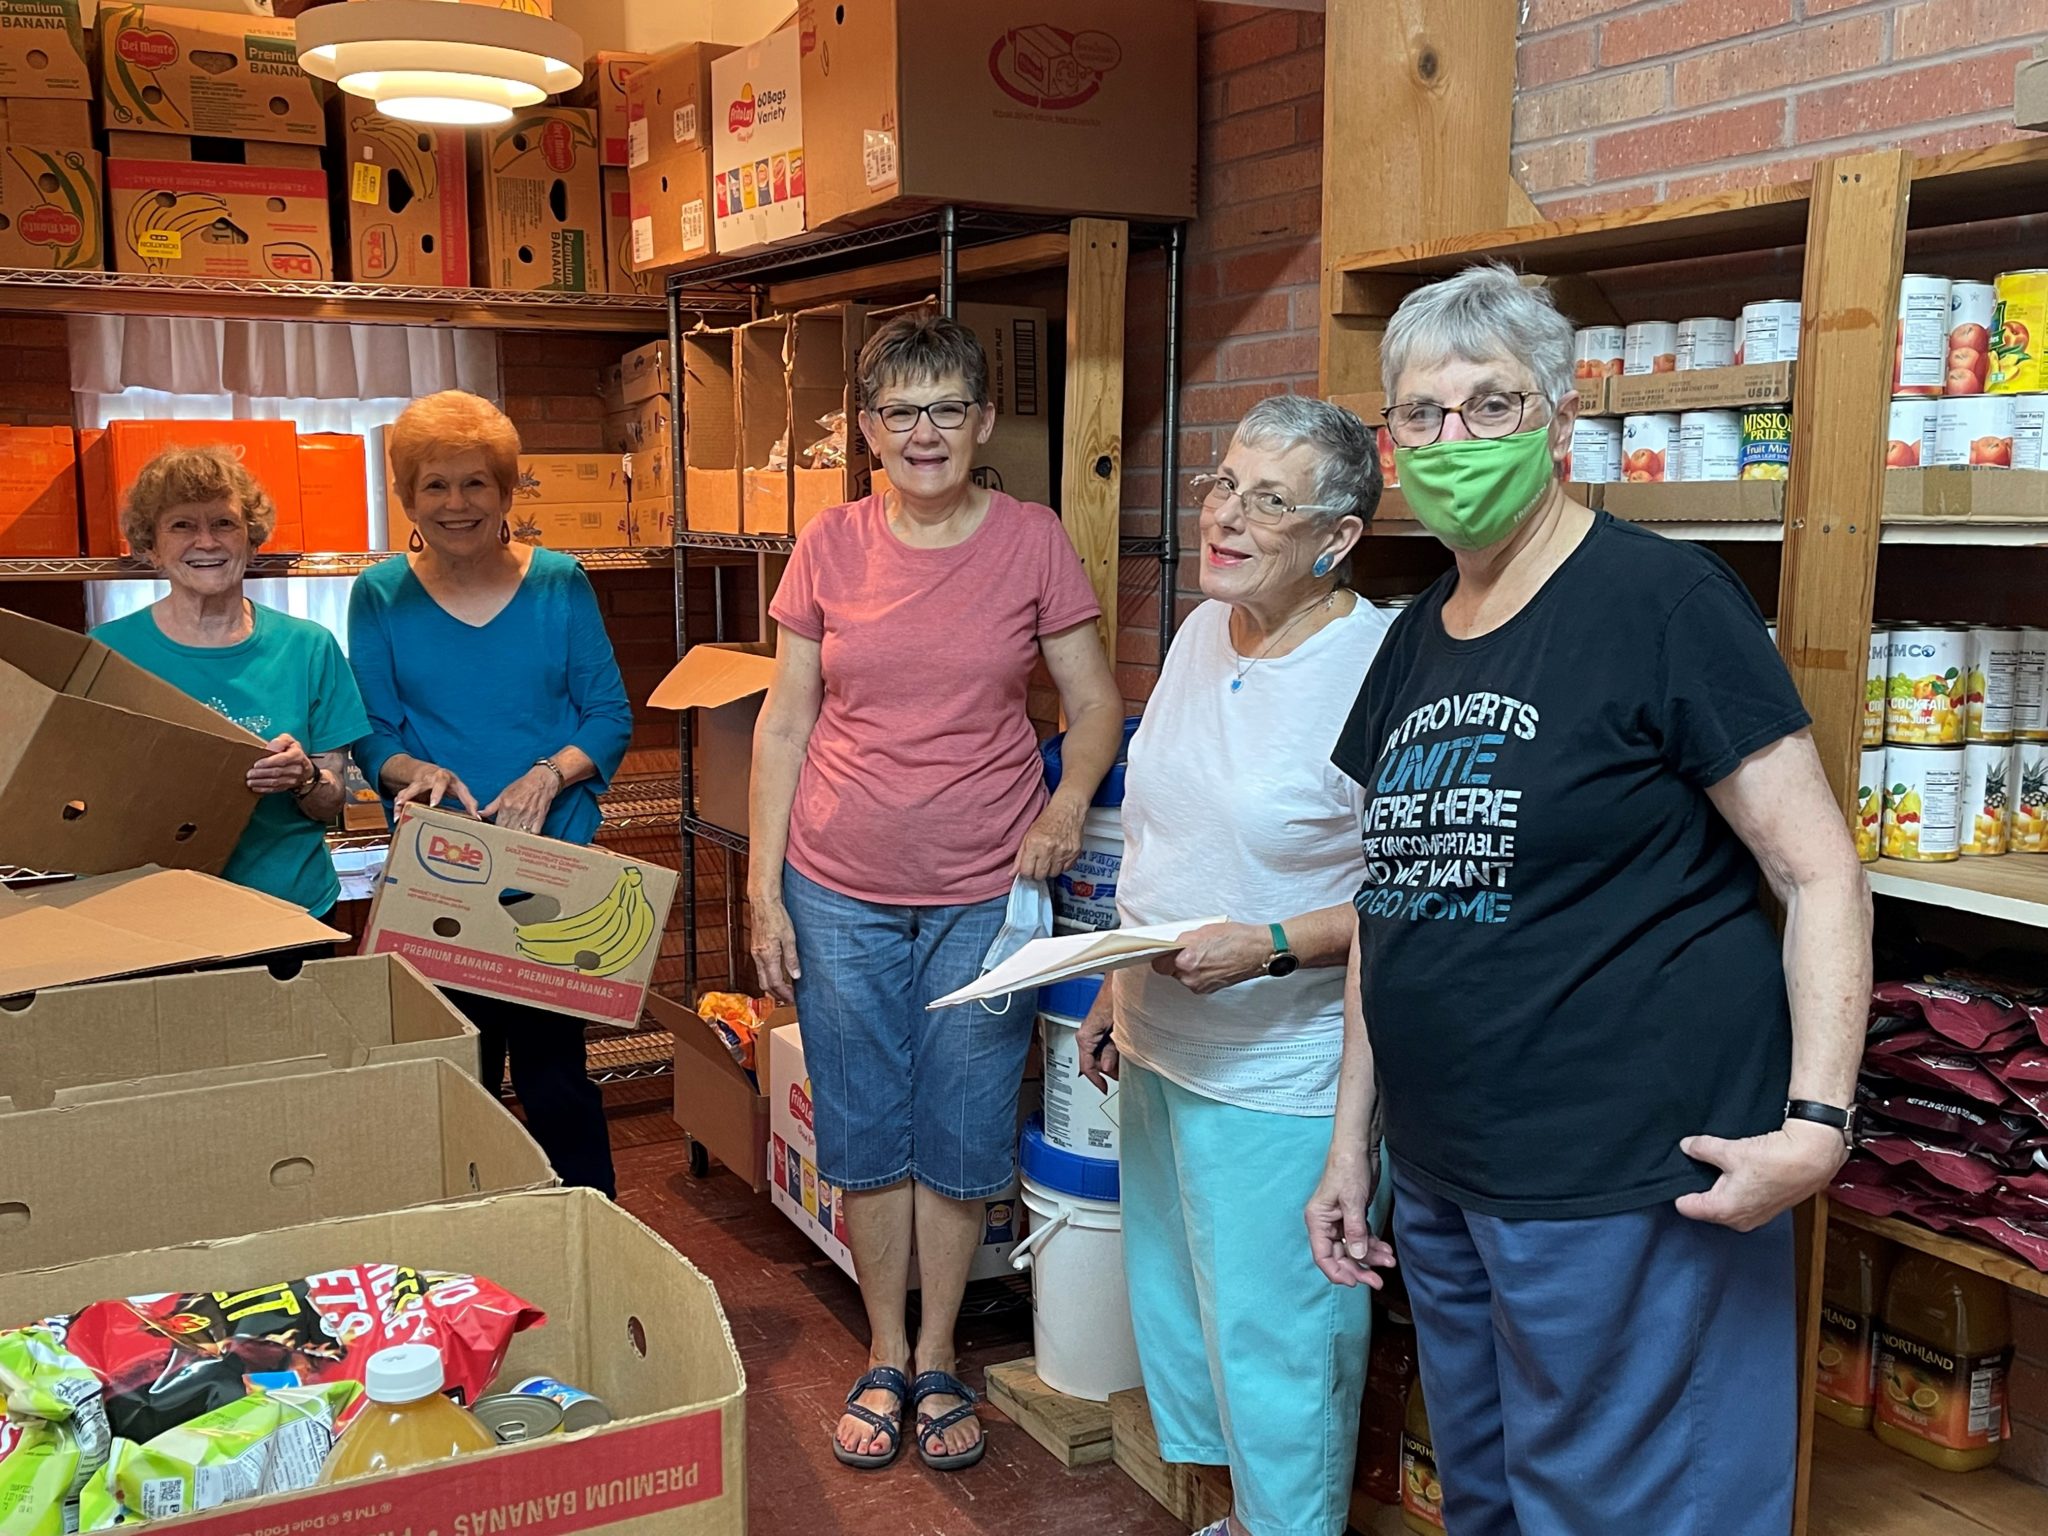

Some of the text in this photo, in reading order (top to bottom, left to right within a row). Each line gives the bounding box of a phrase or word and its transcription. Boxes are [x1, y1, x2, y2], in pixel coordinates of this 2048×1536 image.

[0, 1, 63, 14] Premium
[2, 16, 66, 30] BANANA
[249, 47, 296, 62] Premiu
[757, 105, 787, 125] Variety
[368, 230, 383, 269] Dole
[551, 231, 561, 284] BANANA
[564, 231, 575, 286] Premium
[271, 257, 313, 275] Dole
[1748, 387, 1780, 398] USDA
[1751, 428, 1788, 440] PRIDE
[1746, 444, 1789, 455] Fruit Mix
[1891, 697, 1947, 710] COCKTAIL
[1911, 716, 1936, 724] JUICE
[1377, 734, 1506, 794] UNITE
[1430, 788, 1523, 829] HERE
[427, 835, 483, 865] Dole
[1382, 832, 1515, 857] UNCOMFORTABLE
[1393, 859, 1429, 887] WE
[1428, 859, 1513, 888] WANT
[1076, 906, 1113, 921] SMOOTH
[1368, 888, 1403, 918] GO
[1400, 891, 1512, 923] HOME
[403, 943, 452, 963] PREMIUM
[453, 954, 504, 974] BANANAS
[517, 968, 565, 988] PREMIUM
[566, 979, 614, 998] BANANAS
[1882, 1332, 1954, 1370] NORTHLAND
[453, 1462, 699, 1534] PREMIUM BANANAS
[292, 1516, 325, 1532] Dole
